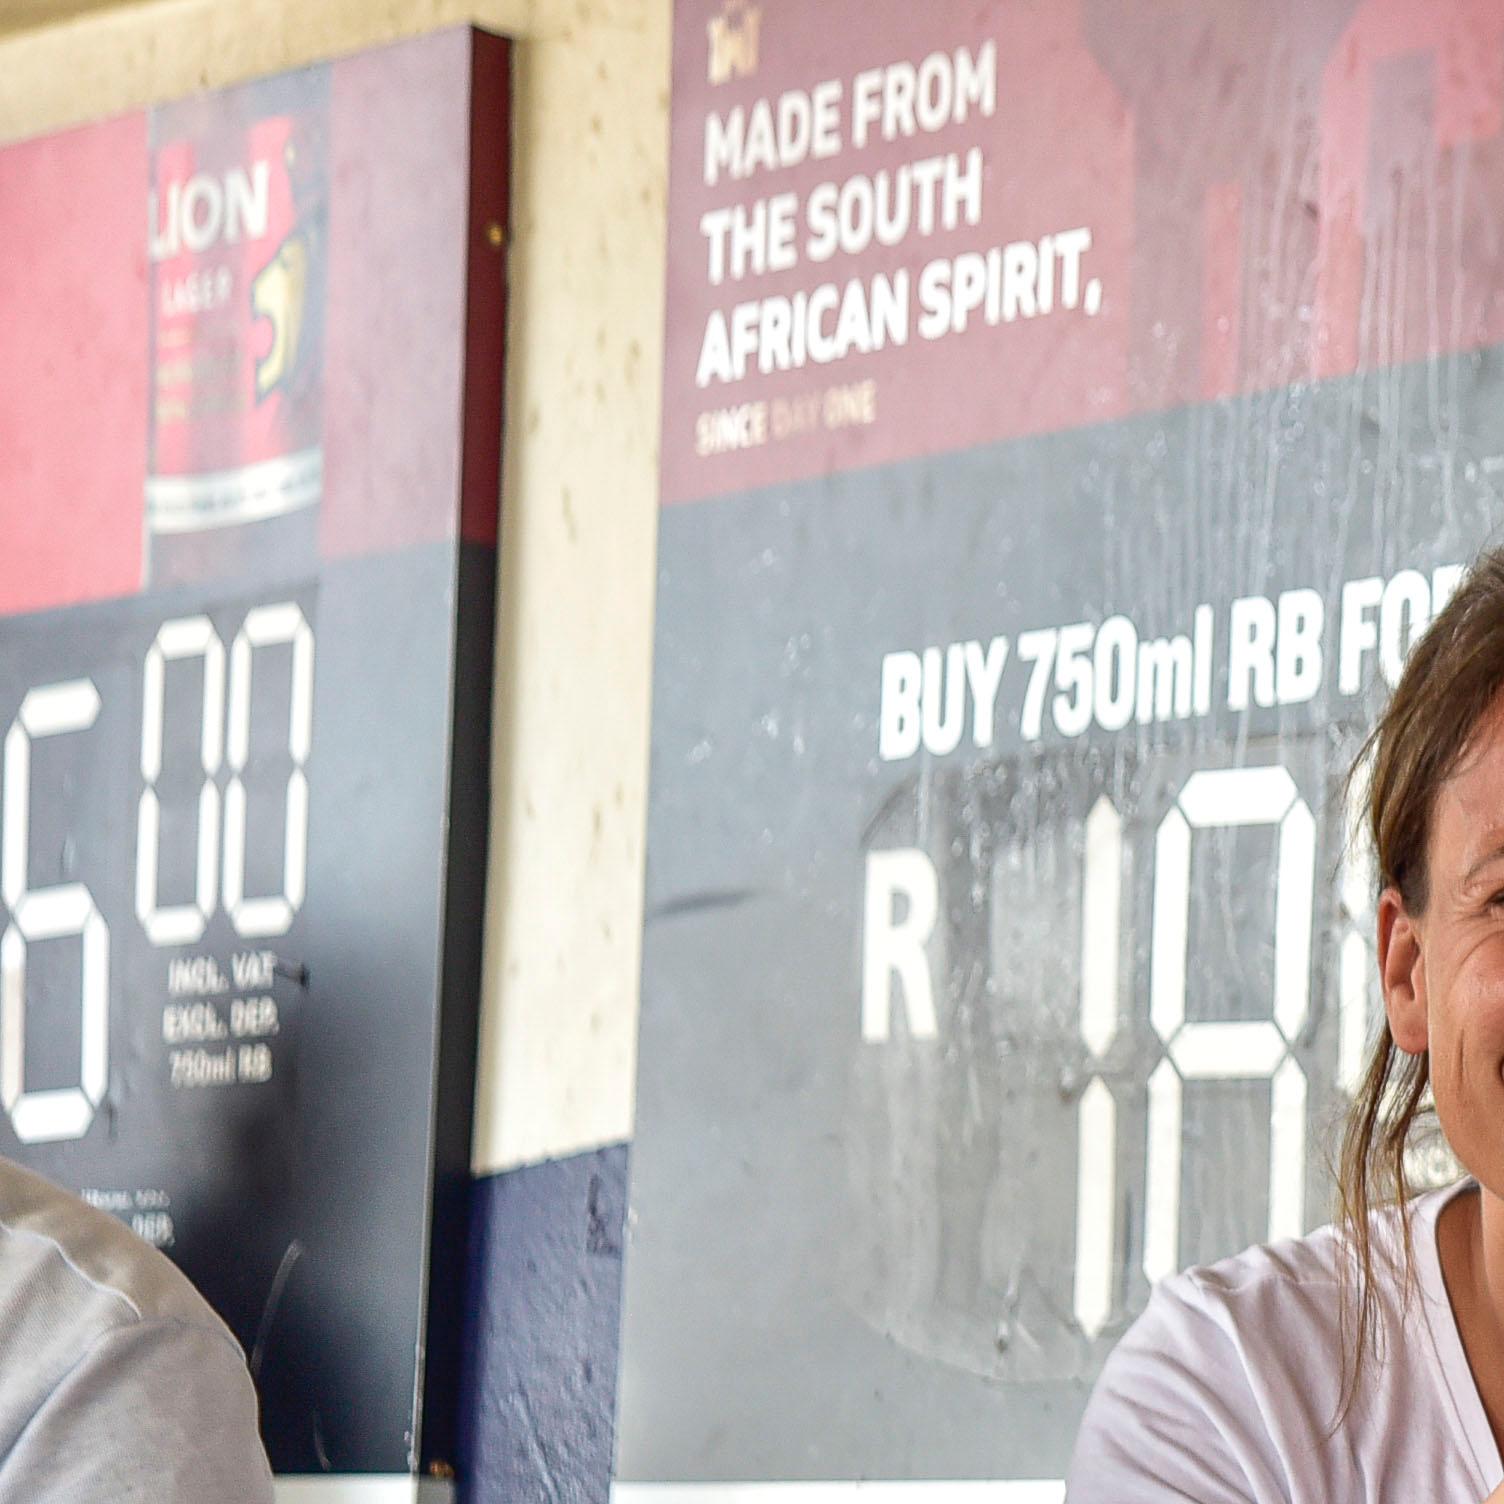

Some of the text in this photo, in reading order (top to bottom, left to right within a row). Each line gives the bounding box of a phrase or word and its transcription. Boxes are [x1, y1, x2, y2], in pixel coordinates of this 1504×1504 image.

[703, 39, 997, 186] MADE FROM
[148, 158, 272, 260] LION
[700, 146, 983, 285] THE SOUTH
[696, 268, 909, 388] AFRICAN
[695, 400, 767, 457] SINCE
[879, 635, 1009, 761] BUY
[1017, 603, 1213, 741] 750ml
[1227, 588, 1325, 711] RB
[861, 848, 941, 1045] R
